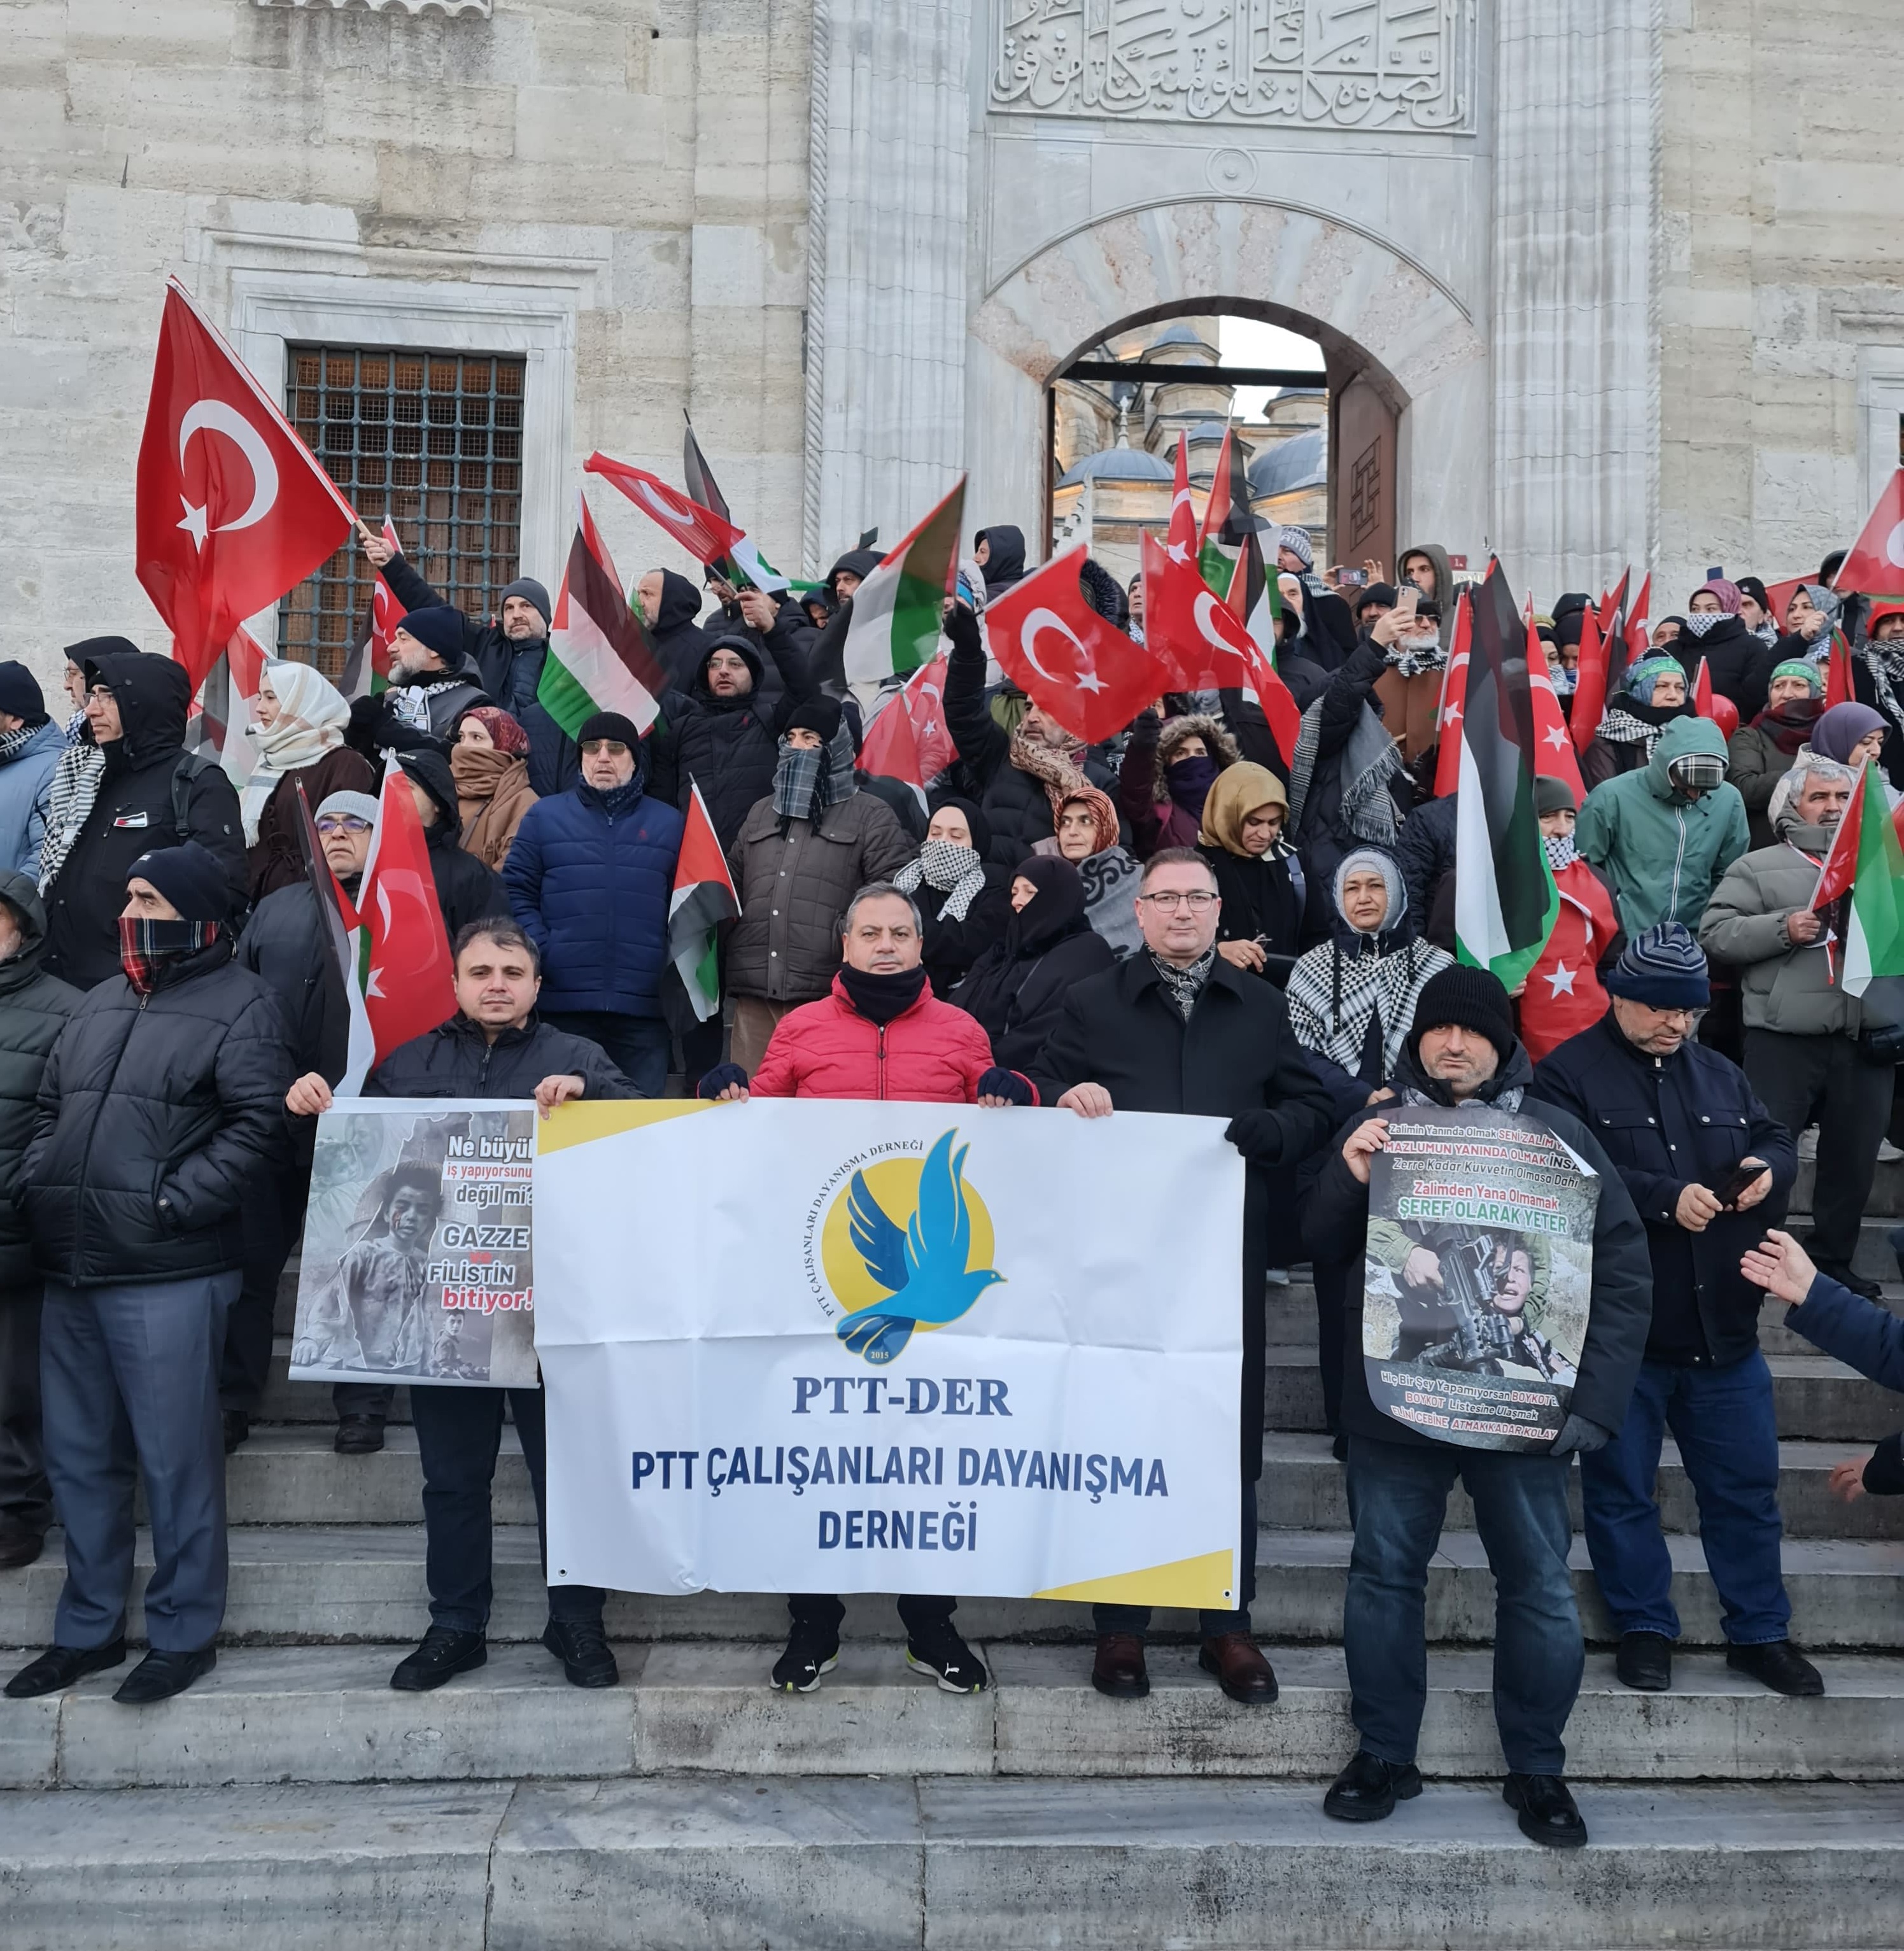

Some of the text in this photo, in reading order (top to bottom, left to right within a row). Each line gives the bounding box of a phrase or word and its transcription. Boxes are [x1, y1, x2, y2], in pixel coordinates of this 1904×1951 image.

[447, 1134, 476, 1157] Ne
[1390, 1124, 1425, 1135] Zalimin
[1426, 1125, 1464, 1136] Yanında
[1466, 1127, 1497, 1139] Olmak
[1498, 1129, 1521, 1141] SENİ
[1521, 1133, 1554, 1148] ZALİM
[1384, 1141, 1581, 1172] MAZLUMUN YANINDA OLMAK İNSA
[447, 1162, 532, 1180] iş yapıyorsunu
[1393, 1159, 1579, 1188] Zerre Kadar Kuvvetin Olmasa Dahi
[455, 1184, 500, 1208] değil
[1414, 1181, 1558, 1209] Zalimden Yana Olmamak
[803, 1139, 924, 1317] PTT ÇALIŞANLARI DAYANIŞMA DERNEĞİ
[1400, 1198, 1568, 1232] ŞEREF OLARAK YETER
[443, 1225, 529, 1249] GAZZE
[429, 1260, 514, 1283] FİLİSTİN
[442, 1286, 533, 1314] bitiyor!
[870, 1351, 889, 1360] 2015
[791, 1376, 1013, 1417] PTT-DER
[1381, 1371, 1398, 1386] Hiç
[1399, 1374, 1414, 1386] Bir
[1415, 1377, 1435, 1391] Şey
[1437, 1379, 1511, 1401] Yapamıyorsan
[1511, 1390, 1551, 1406] BOYKOT
[1406, 1391, 1539, 1421] BOYKOT Listesine Ulaşmak
[1415, 1412, 1449, 1428] CEBİNE
[1451, 1418, 1487, 1432] ATMAK
[1486, 1421, 1523, 1436] KADAR
[1522, 1427, 1558, 1440] KOLAY
[632, 1446, 1169, 1505] PTT ÇALIŞANLARI DAYANIŞMA
[818, 1500, 978, 1552] DERNEĞİ
